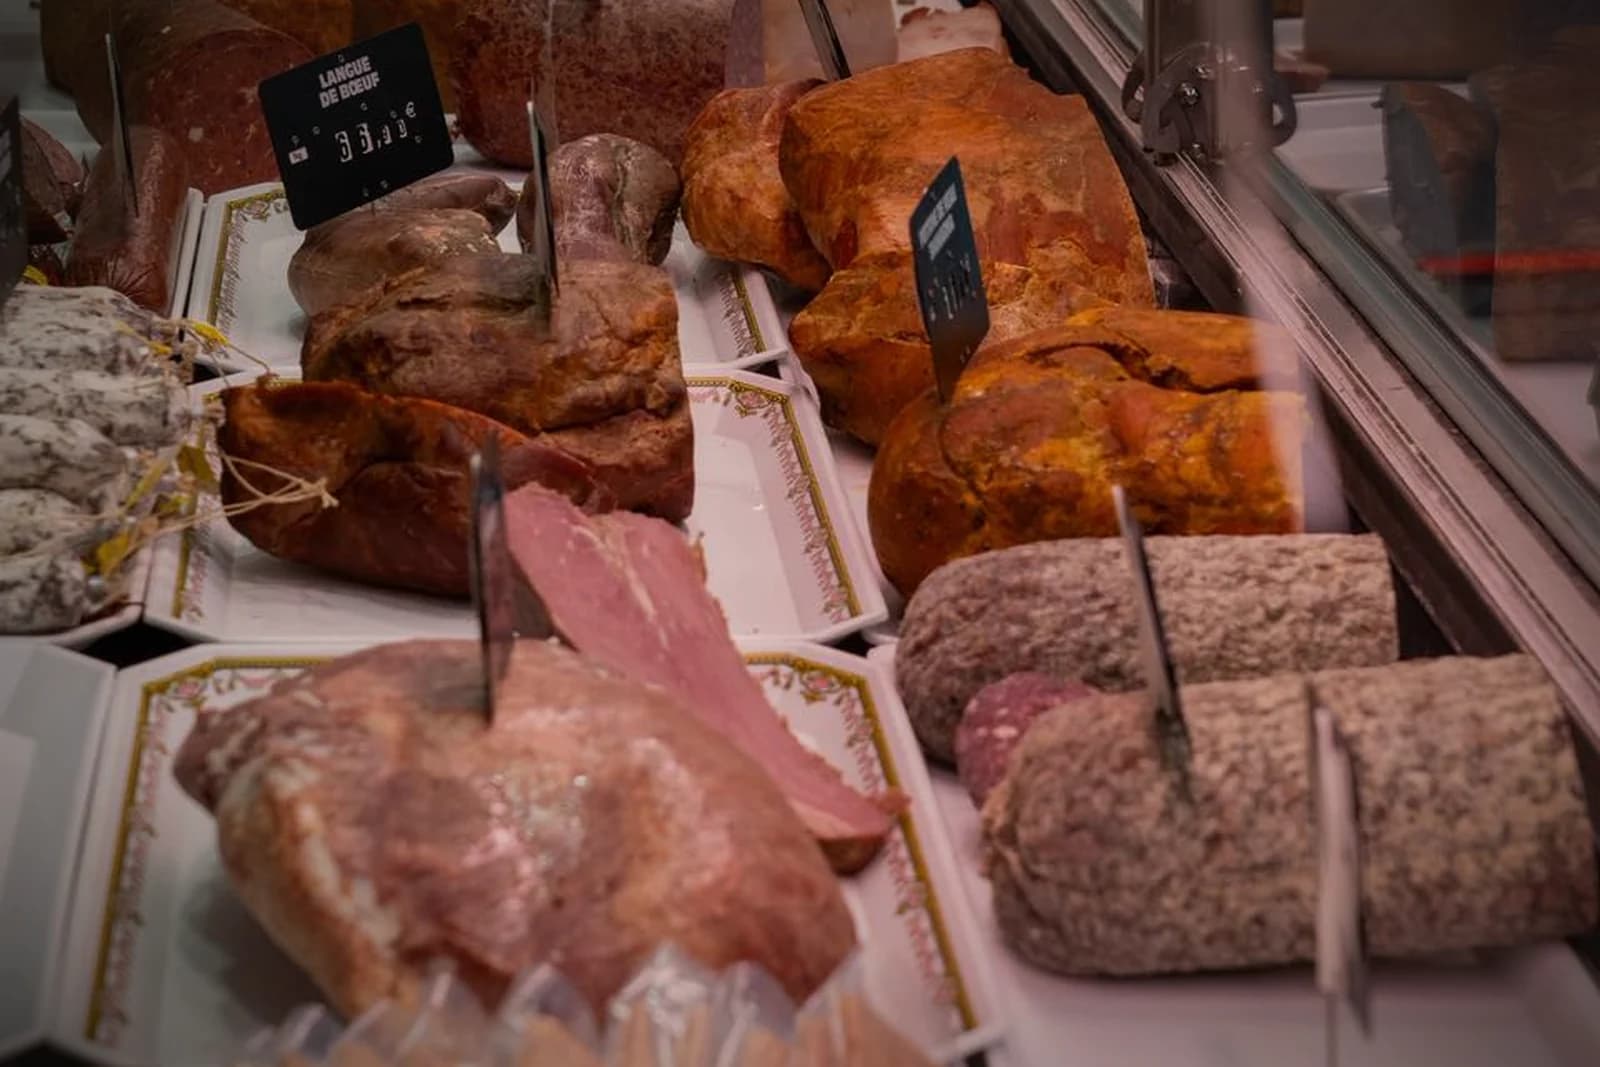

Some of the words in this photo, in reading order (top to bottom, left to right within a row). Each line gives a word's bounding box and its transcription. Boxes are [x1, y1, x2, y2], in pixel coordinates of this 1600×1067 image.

[319, 55, 371, 89] LANGUE
[319, 87, 340, 109] DE
[338, 71, 380, 100] BŒUF
